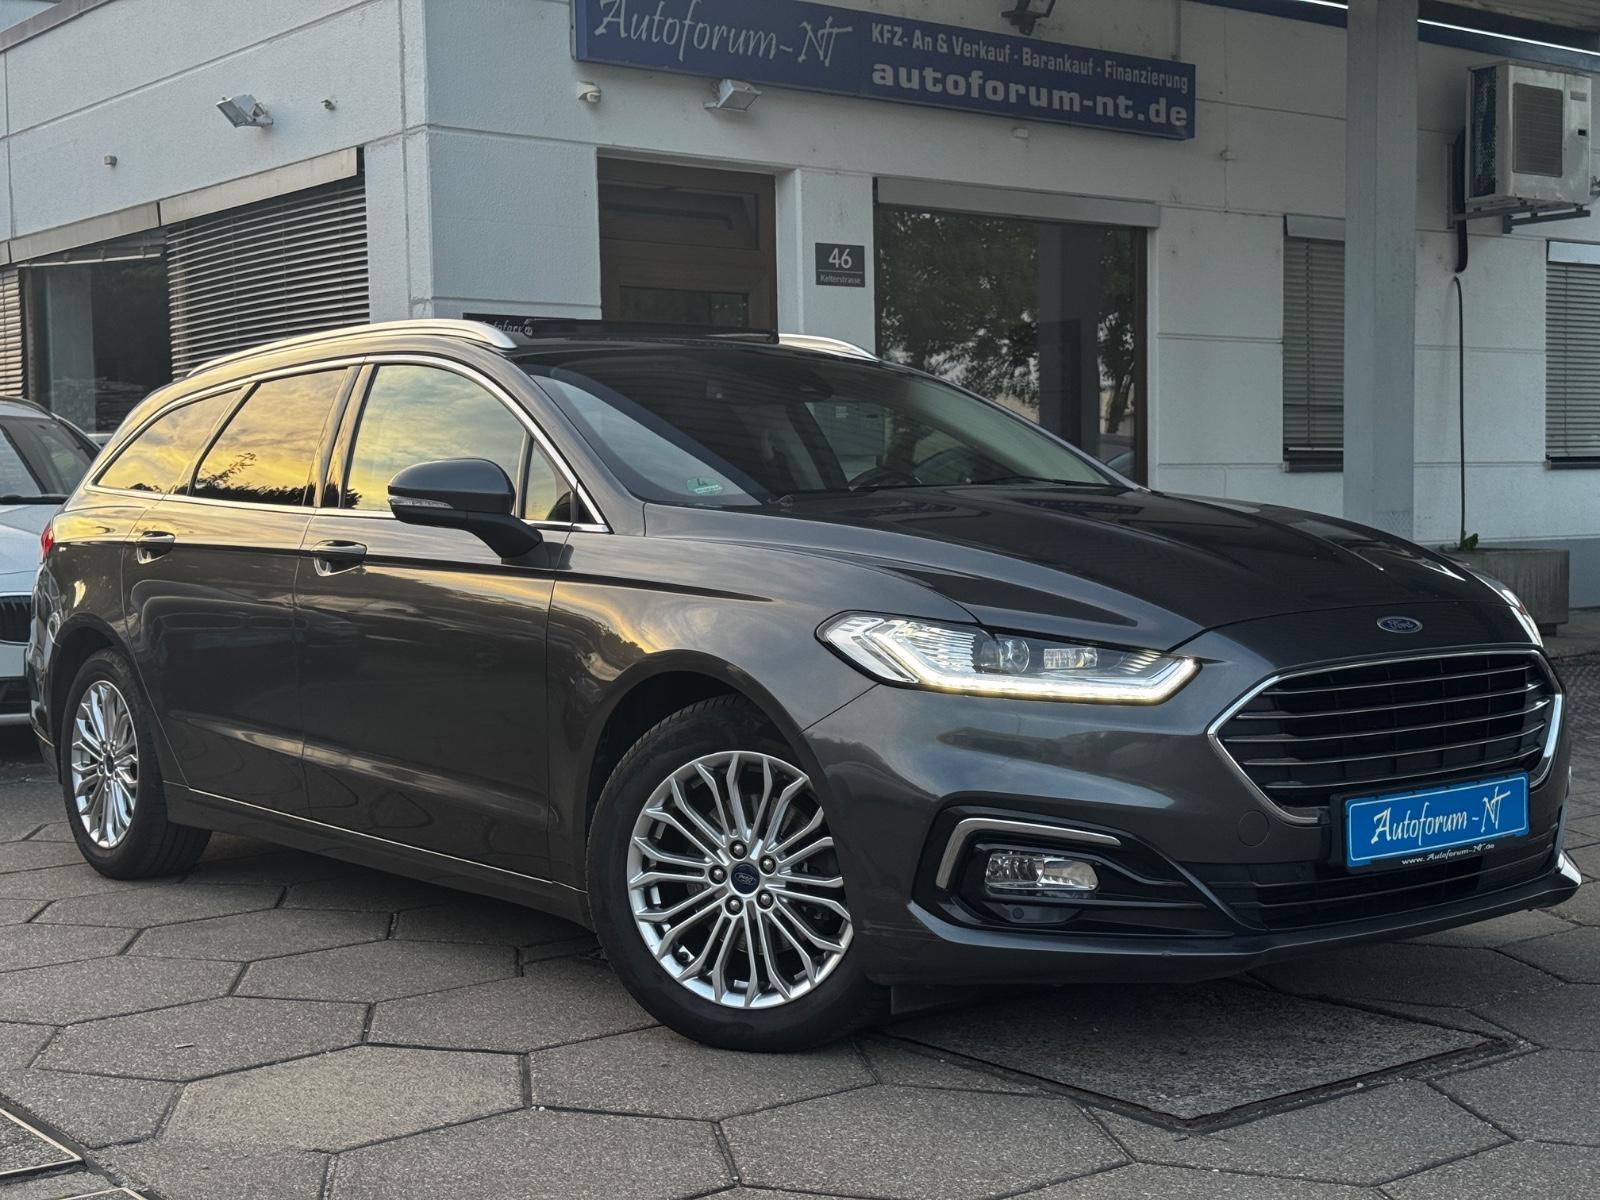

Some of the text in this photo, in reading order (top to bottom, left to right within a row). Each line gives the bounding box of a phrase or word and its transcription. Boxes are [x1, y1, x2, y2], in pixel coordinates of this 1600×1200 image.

[871, 62, 1188, 127] autoforum-nt.de
[912, 29, 933, 52] An
[936, 33, 948, 54] &
[952, 36, 1010, 64] Verkauf
[1022, 47, 1094, 76] Barankauf
[1105, 60, 1188, 95] Finanzierung
[828, 247, 852, 269] 46
